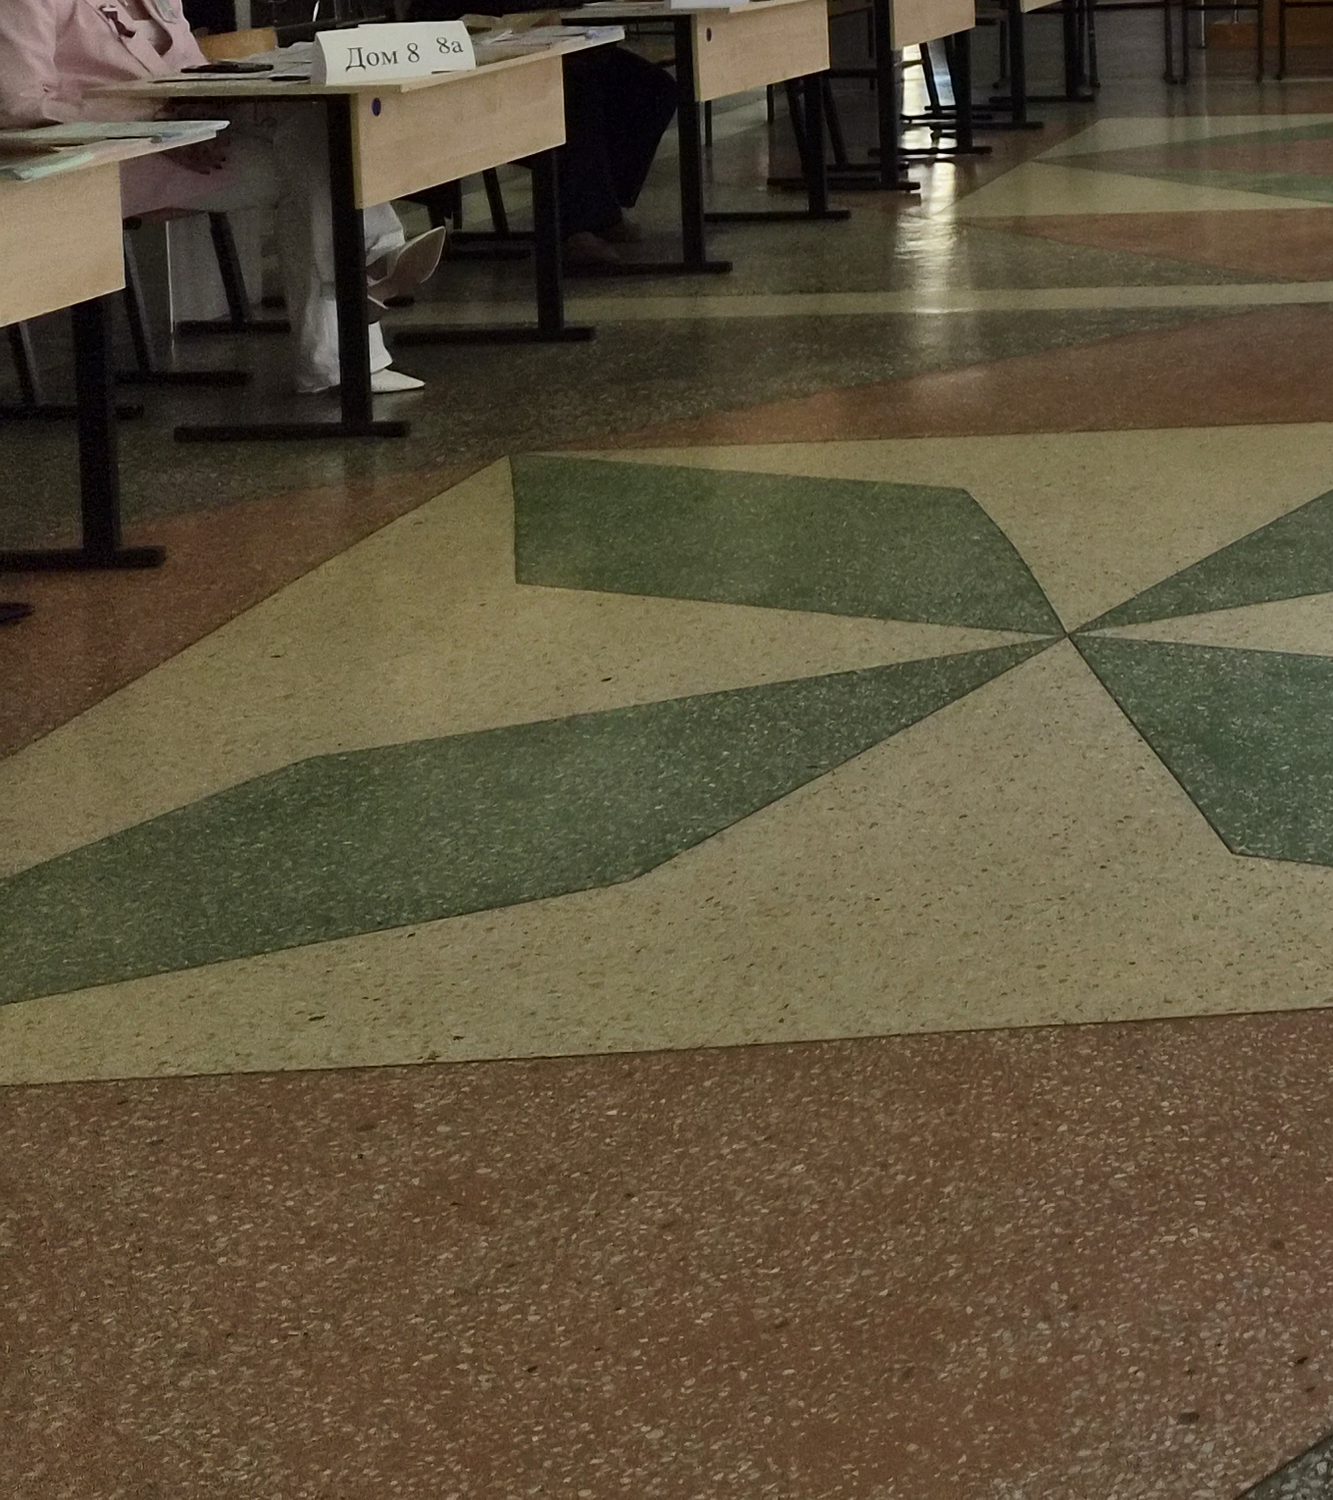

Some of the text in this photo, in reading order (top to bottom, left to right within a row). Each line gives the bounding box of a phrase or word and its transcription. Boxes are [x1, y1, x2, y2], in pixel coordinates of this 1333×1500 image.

[345, 36, 464, 73] Дом 8 8а
